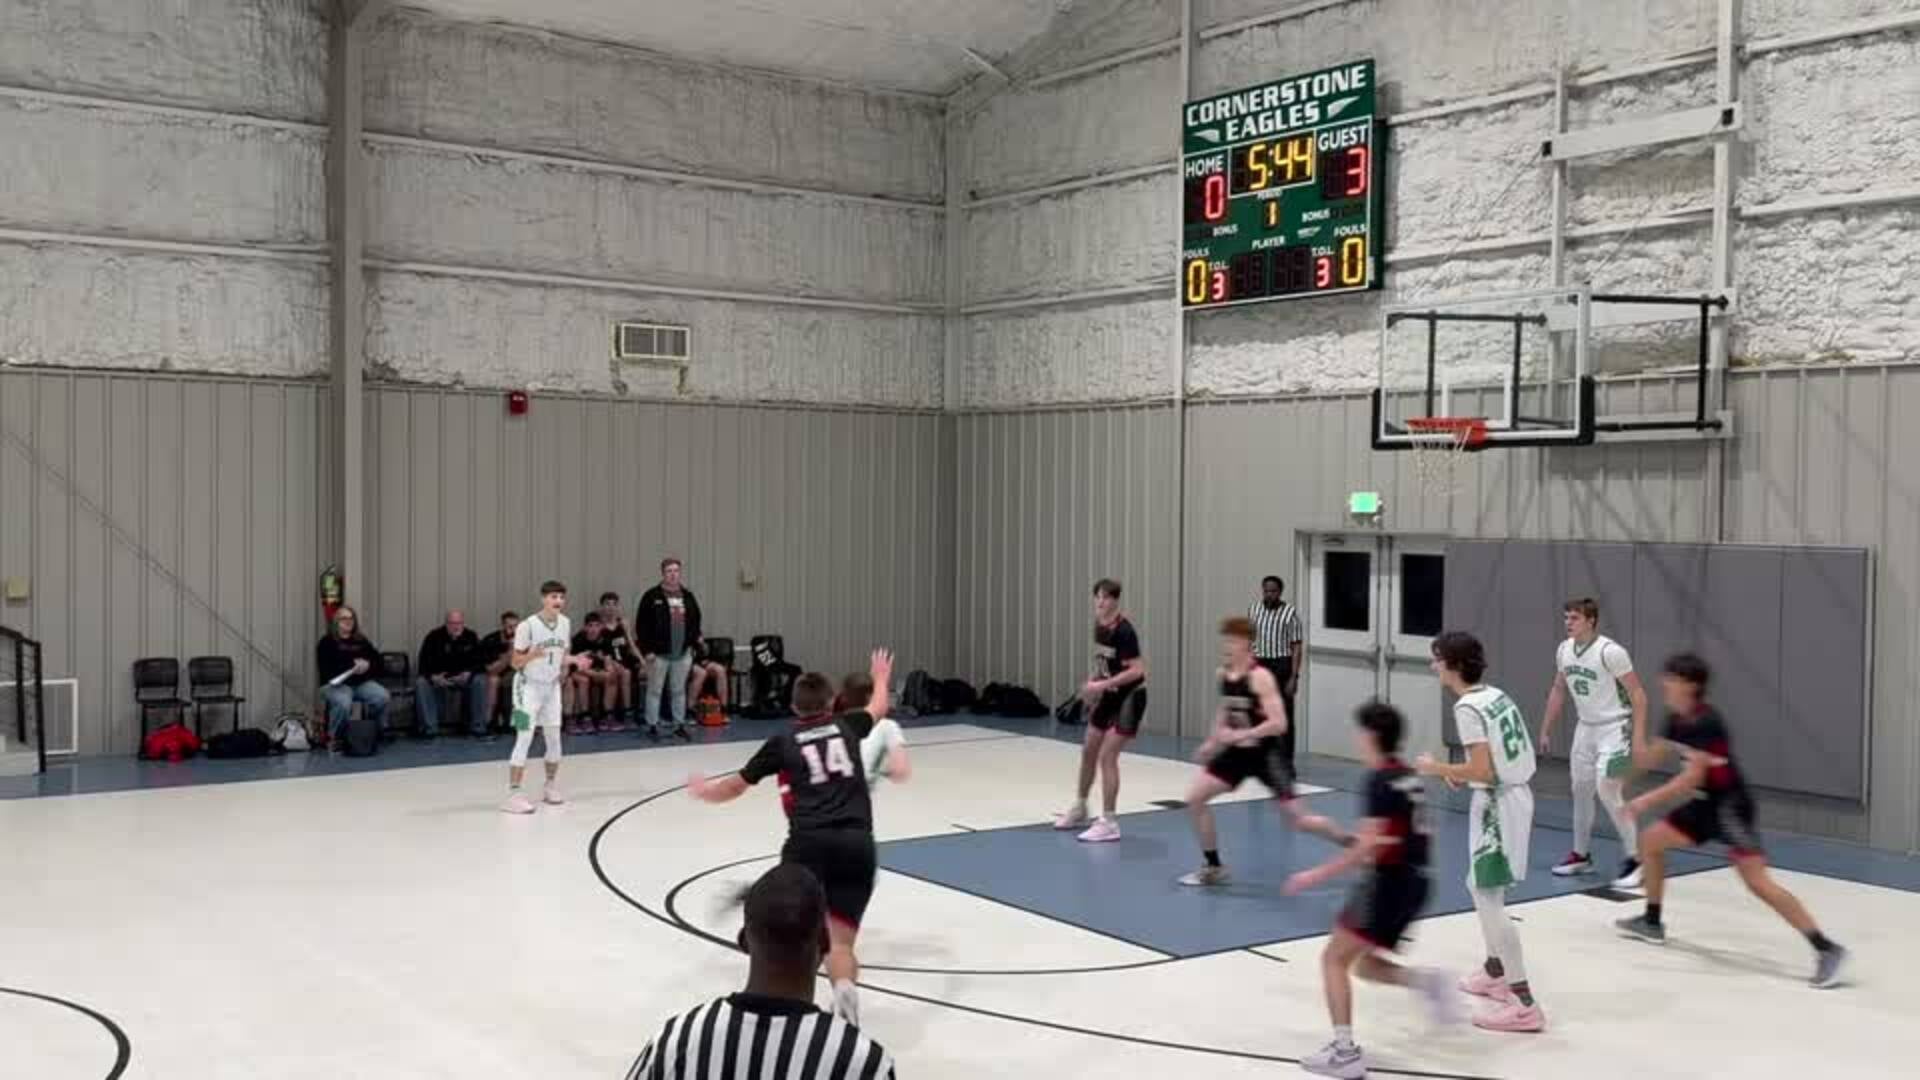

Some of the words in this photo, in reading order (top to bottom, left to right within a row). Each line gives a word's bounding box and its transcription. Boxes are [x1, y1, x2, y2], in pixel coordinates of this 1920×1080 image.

[1187, 65, 1366, 127] CORNERSTONE
[1226, 101, 1320, 141] EAGLES
[1318, 125, 1368, 151] GUEST
[1186, 155, 1225, 177] HOME
[1249, 137, 1313, 190] 5:44
[1347, 147, 1366, 195] 3
[1205, 175, 1225, 219] 0
[1269, 201, 1277, 226] 1
[1252, 235, 1285, 250] PLAYER
[1333, 224, 1366, 237] FOULS
[1316, 257, 1331, 288] 3
[1342, 237, 1363, 284] 0
[1188, 259, 1207, 303] 0
[1213, 272, 1225, 300] 3
[801, 736, 854, 784] 14
